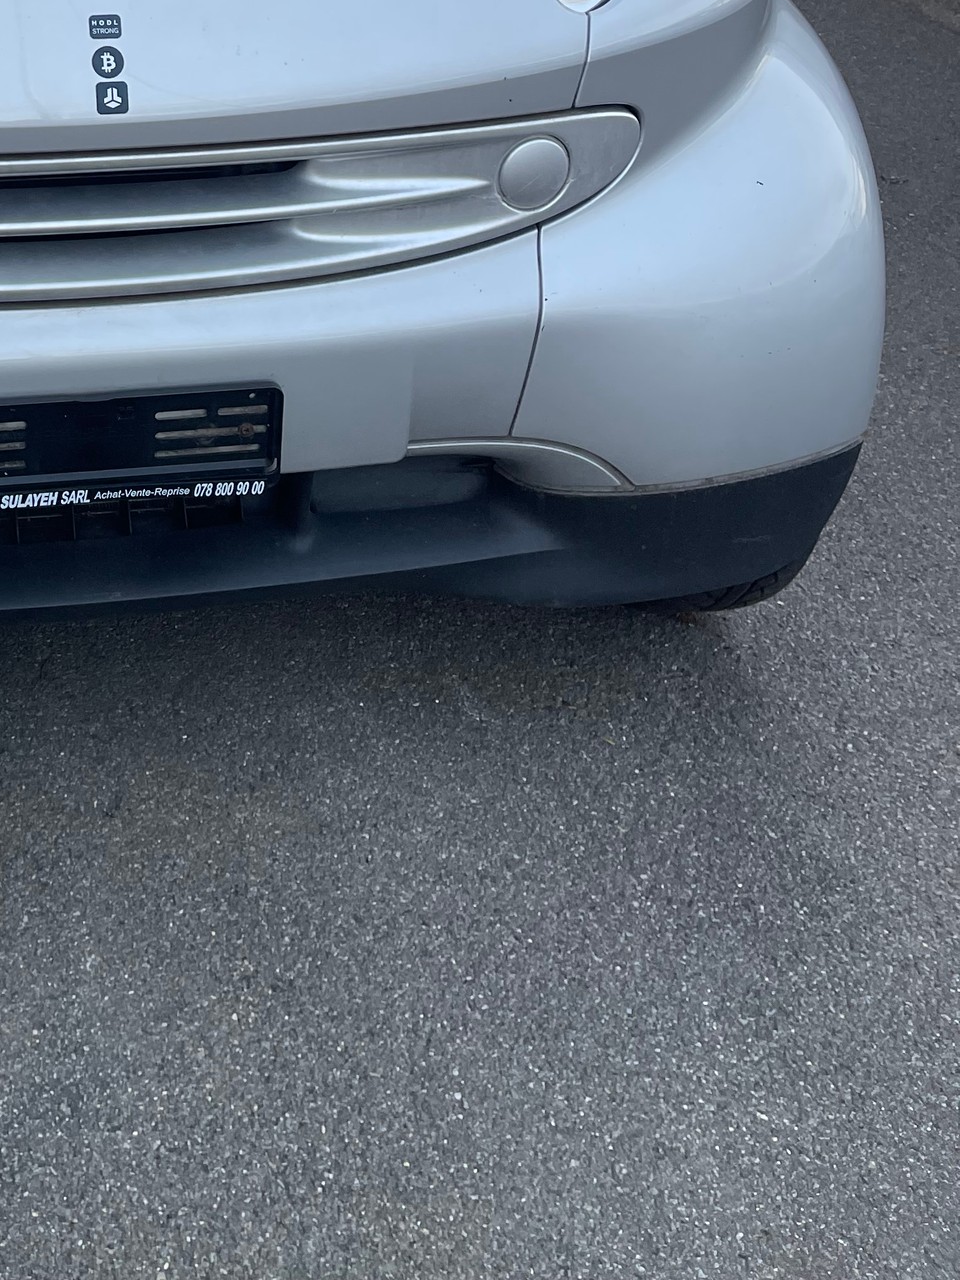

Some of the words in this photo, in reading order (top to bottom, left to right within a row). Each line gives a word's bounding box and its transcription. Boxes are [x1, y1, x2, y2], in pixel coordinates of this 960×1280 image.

[1, 491, 58, 509] SULAYEH
[61, 489, 91, 504] SARL
[94, 486, 190, 500] Achat-Vente-Reprise
[194, 483, 214, 497] 078
[215, 482, 234, 496] 800
[236, 481, 249, 495] 90
[251, 481, 265, 495] 00
